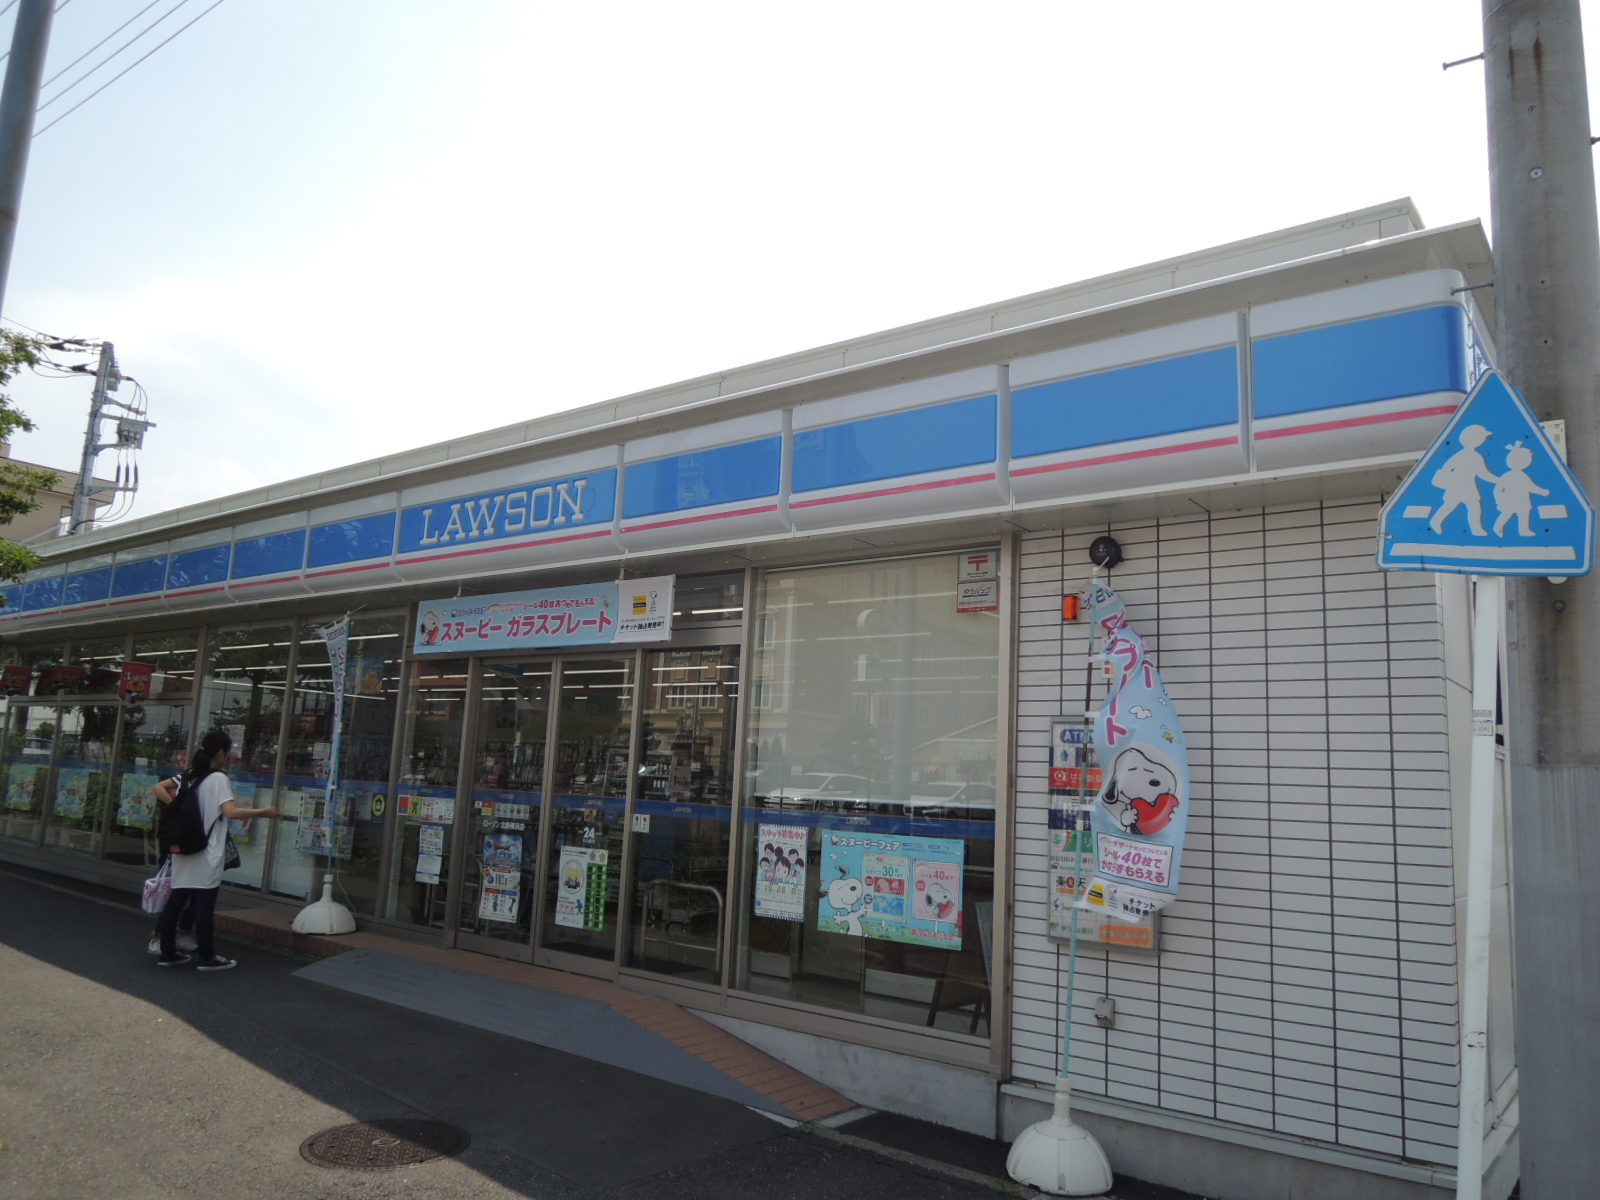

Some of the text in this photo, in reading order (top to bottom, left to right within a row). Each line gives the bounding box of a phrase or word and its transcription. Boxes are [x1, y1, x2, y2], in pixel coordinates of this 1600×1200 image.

[419, 479, 588, 545] LAWSON
[440, 610, 612, 642] スヌーピー ガラスプレート
[583, 826, 595, 839] 24
[839, 837, 901, 851] スヌーピーフェア
